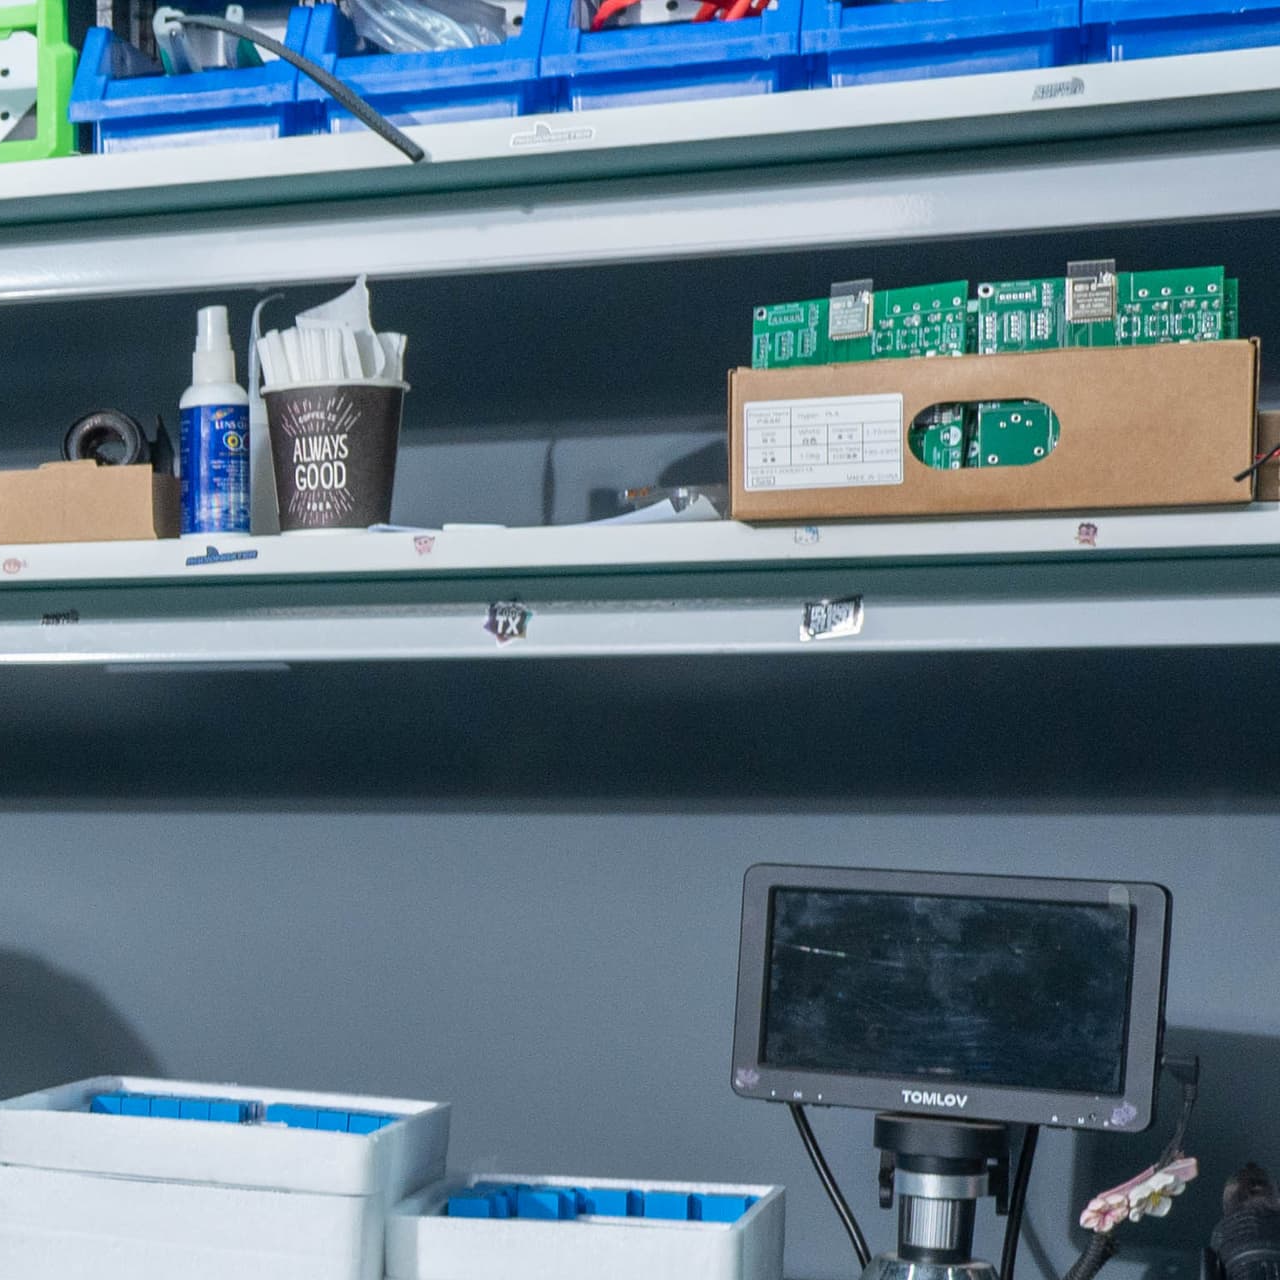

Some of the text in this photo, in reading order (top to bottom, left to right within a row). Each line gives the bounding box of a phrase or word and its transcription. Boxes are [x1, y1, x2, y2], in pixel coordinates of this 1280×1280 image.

[293, 433, 349, 463] ALWAYS
[295, 460, 347, 491] GOOD
[495, 615, 521, 635] TX
[901, 1089, 968, 1108] TOMLOV
